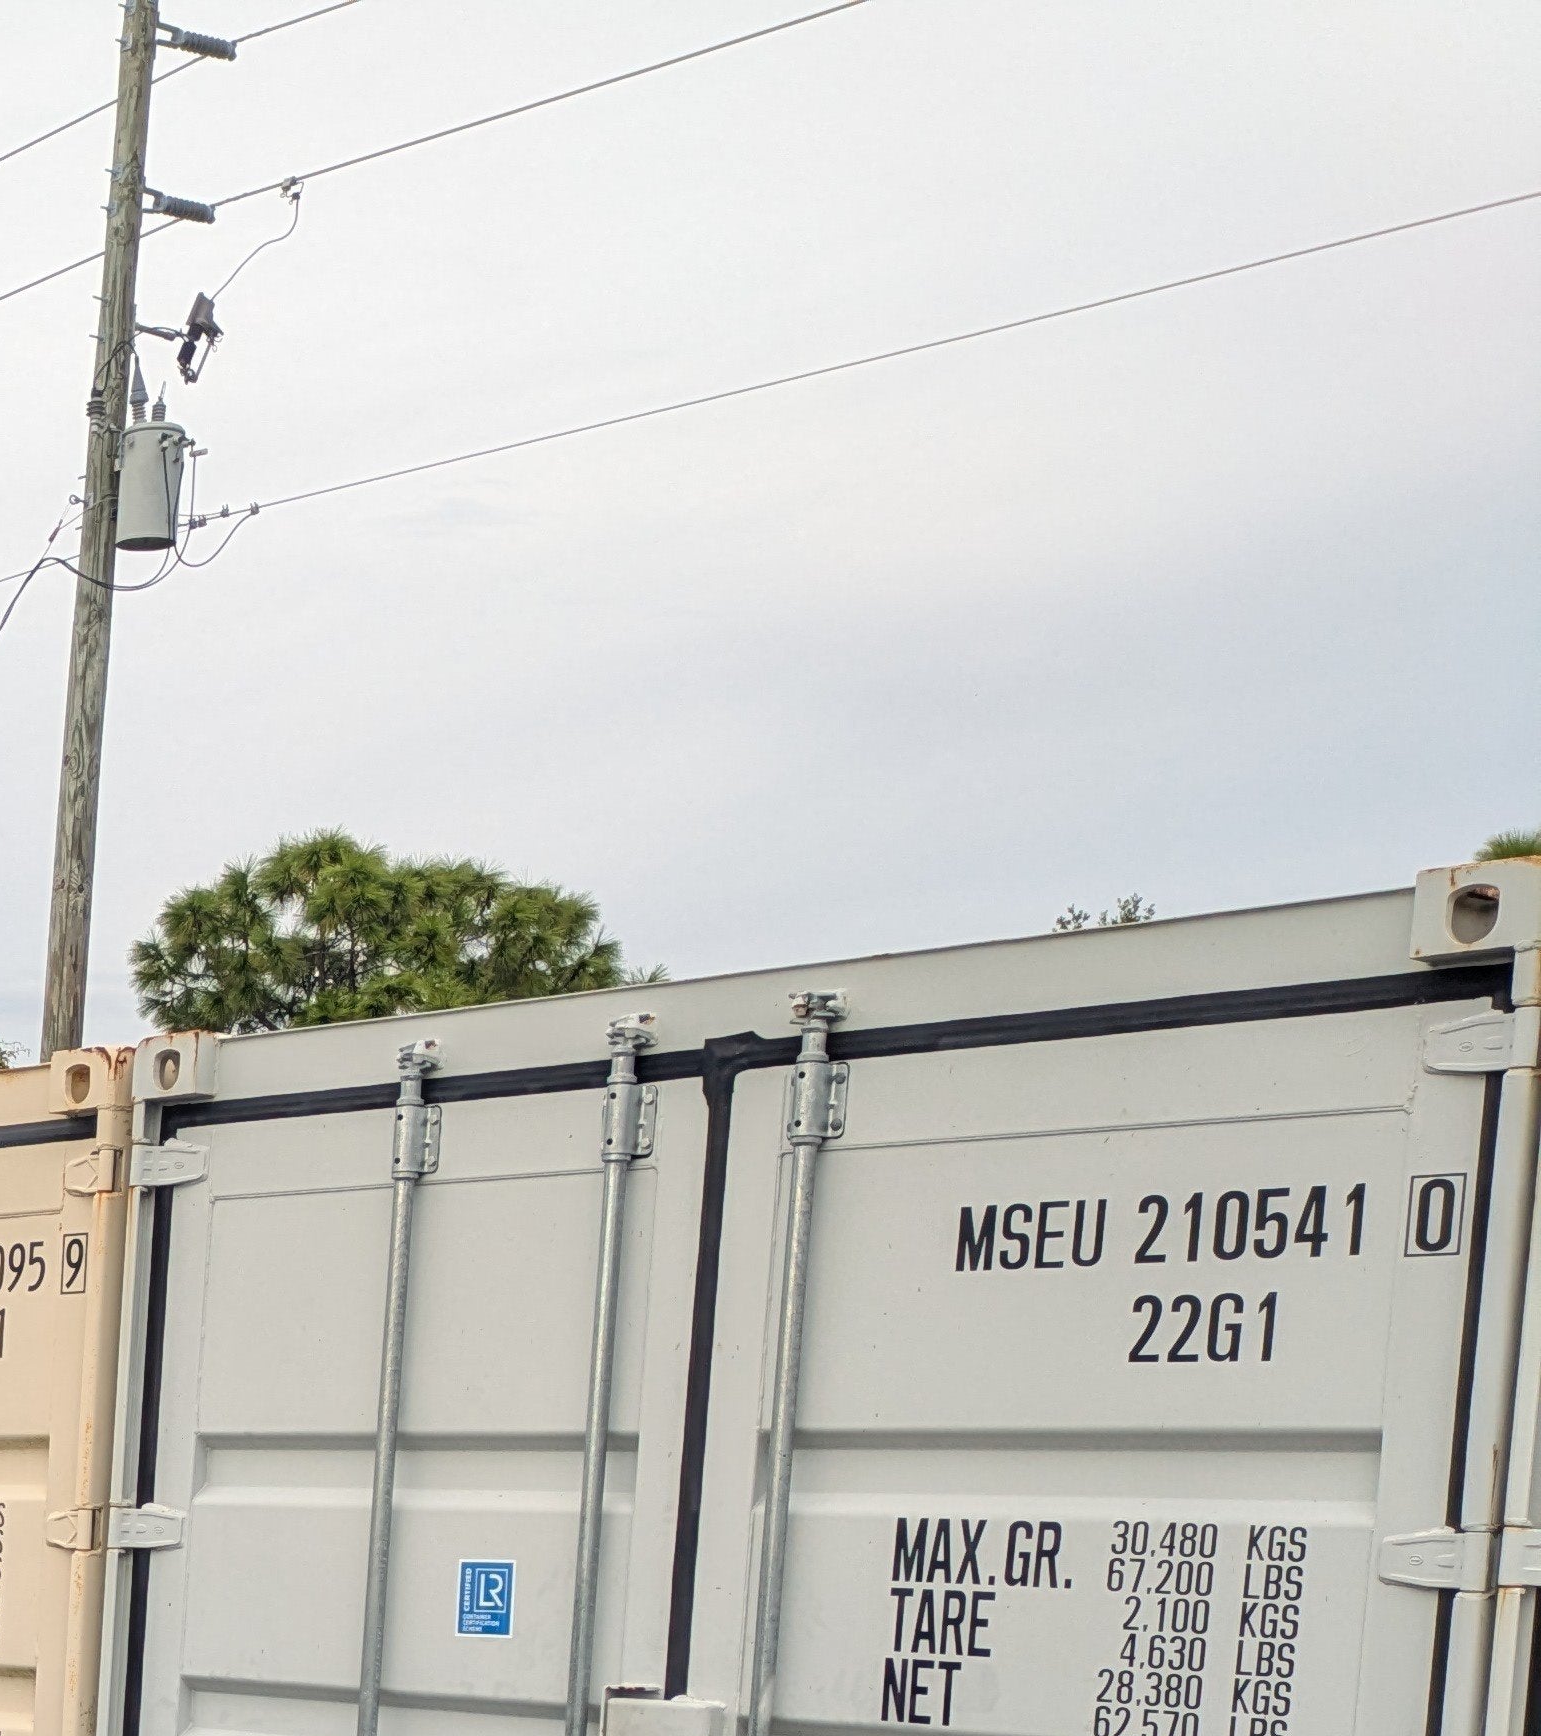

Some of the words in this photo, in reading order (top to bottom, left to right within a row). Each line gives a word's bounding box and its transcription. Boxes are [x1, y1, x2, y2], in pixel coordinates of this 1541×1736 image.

[955, 1198, 1108, 1272] MSEU
[1133, 1182, 1367, 1265] 210541
[1414, 1178, 1457, 1253] 0
[64, 1237, 85, 1290] 9
[1127, 1291, 1278, 1363] 22G1
[1110, 1520, 1218, 1561] 30,480
[1246, 1524, 1308, 1563] KGS
[478, 1573, 504, 1607] LR
[1106, 1556, 1214, 1600] 67,200
[1242, 1563, 1304, 1602] LBS
[888, 1588, 993, 1657] TARE
[1122, 1596, 1210, 1638] 2,100
[1238, 1601, 1300, 1640] KGS
[1119, 1635, 1207, 1674] 4,630
[1234, 1639, 1296, 1679] LBS
[880, 1657, 962, 1727] NET
[1095, 1667, 1204, 1712] 28,380
[1230, 1676, 1292, 1719] KGS
